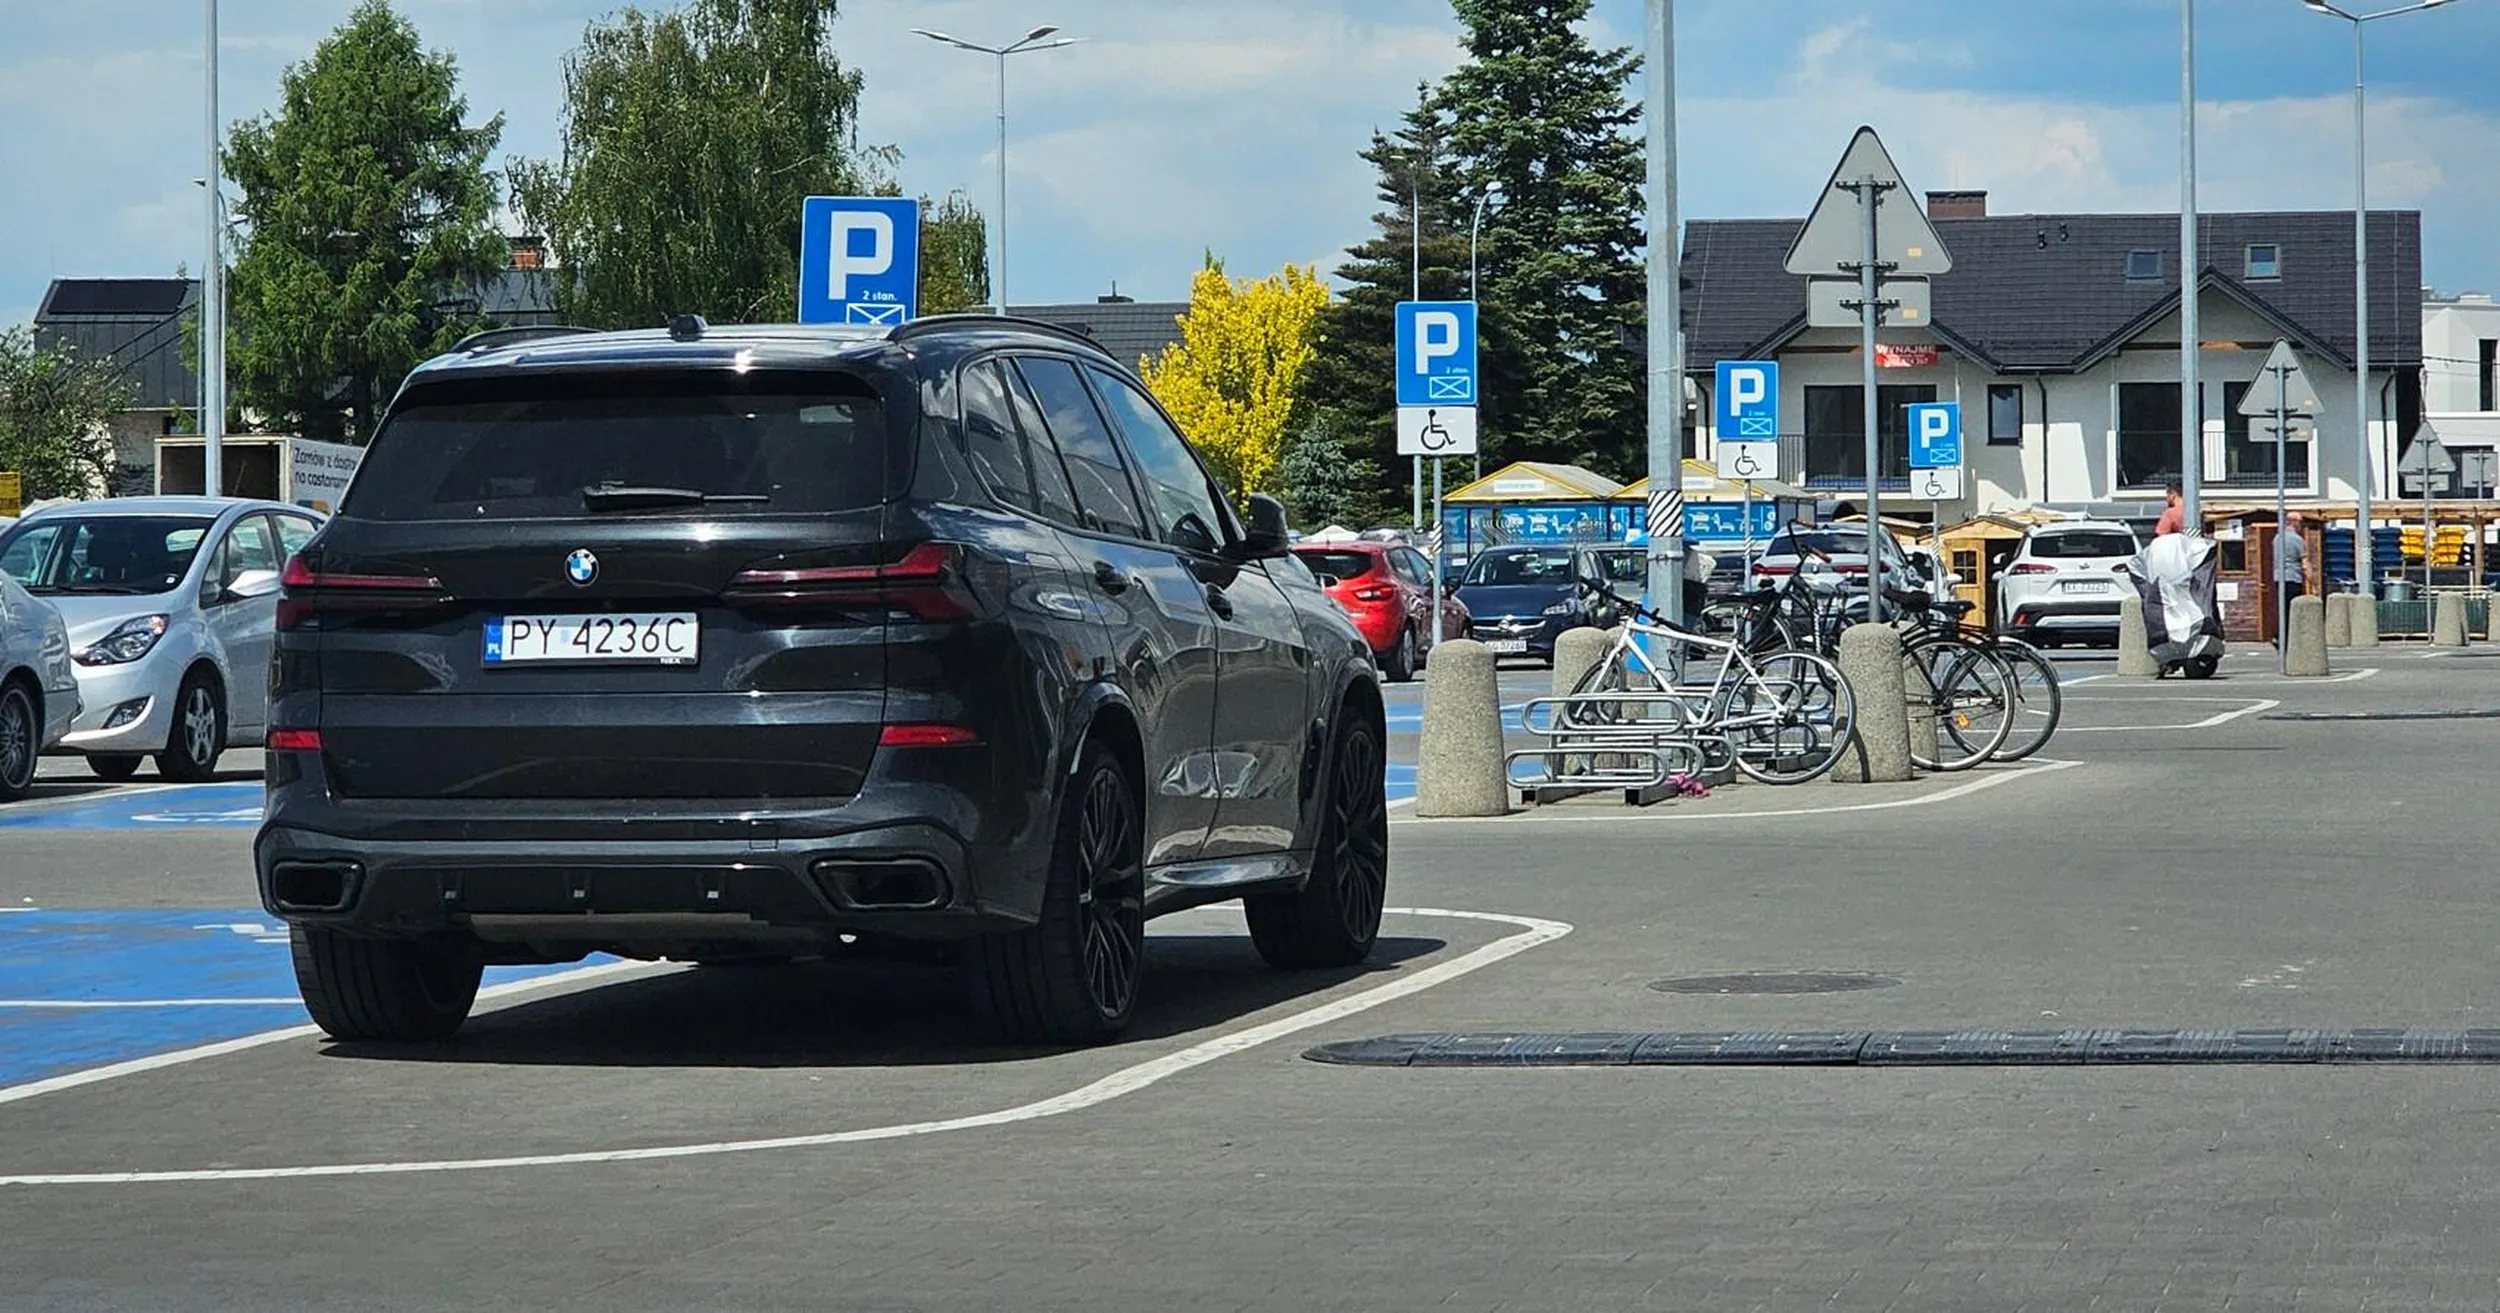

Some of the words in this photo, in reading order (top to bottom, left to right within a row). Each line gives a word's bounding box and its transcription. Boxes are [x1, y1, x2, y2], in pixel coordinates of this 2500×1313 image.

[829, 211, 894, 300] P
[862, 290, 870, 301] 2
[872, 291, 898, 302] stan.
[1415, 312, 1460, 374] P
[1730, 368, 1765, 416] P
[1921, 409, 1949, 448] P
[510, 619, 556, 655] PY
[572, 617, 686, 654] 4236C
